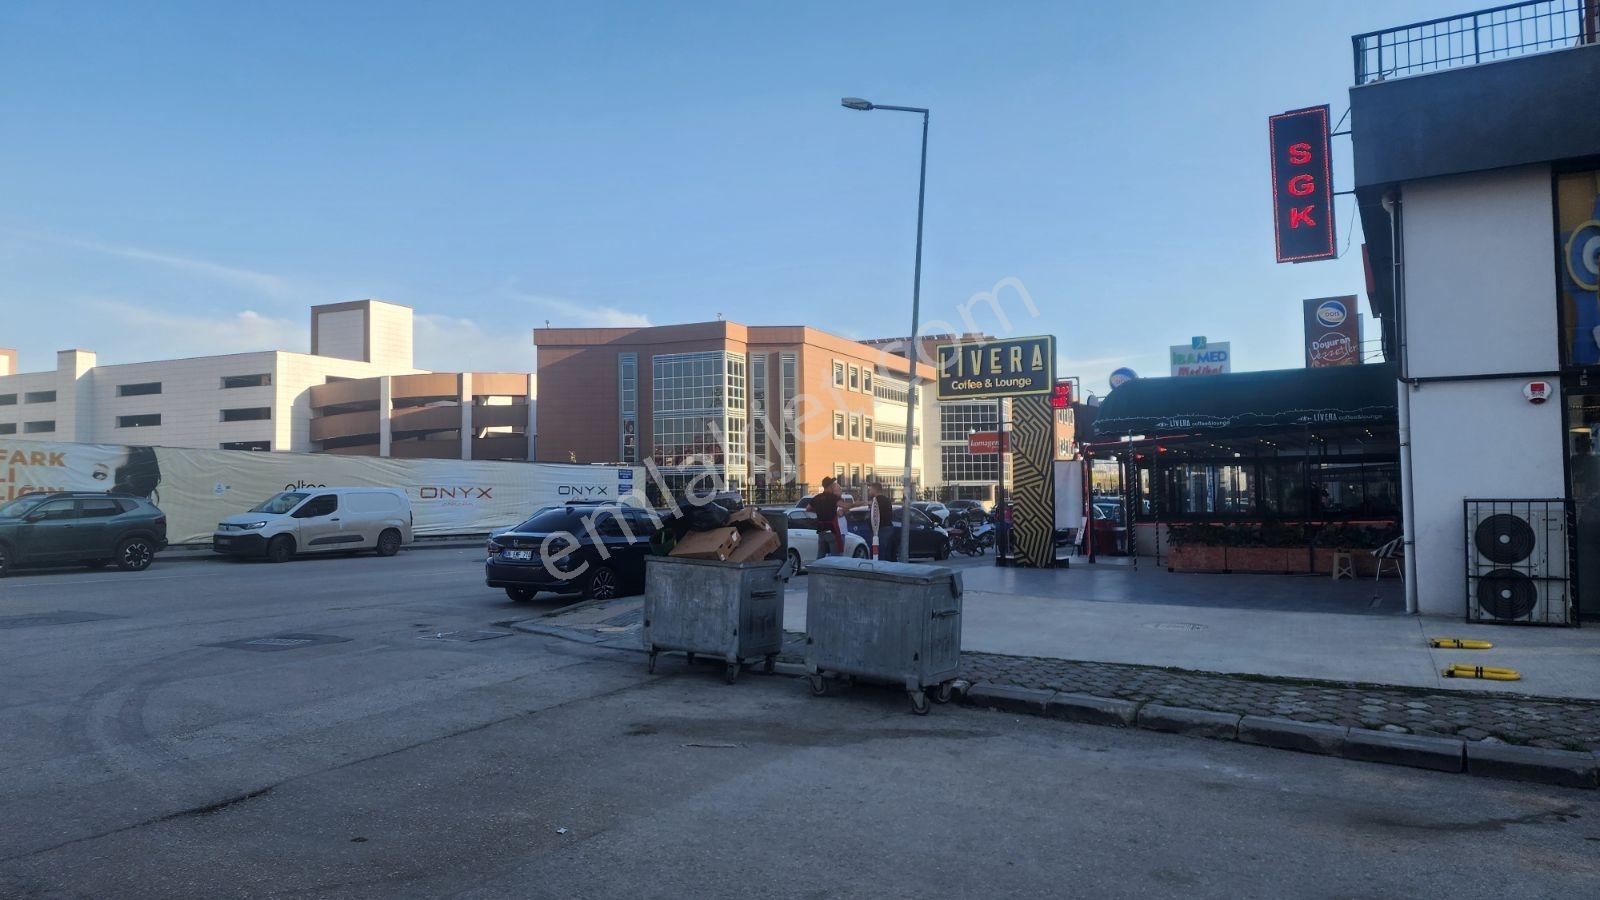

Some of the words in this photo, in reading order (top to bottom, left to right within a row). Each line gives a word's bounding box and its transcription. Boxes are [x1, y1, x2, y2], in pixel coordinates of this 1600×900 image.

[1288, 142, 1316, 229] SGK
[1312, 337, 1350, 350] Doyuran
[952, 380, 982, 390] Coffee
[985, 379, 993, 388] &
[996, 377, 1032, 388] Lounge
[420, 487, 493, 499] ONYX
[558, 485, 608, 496] ONYX
